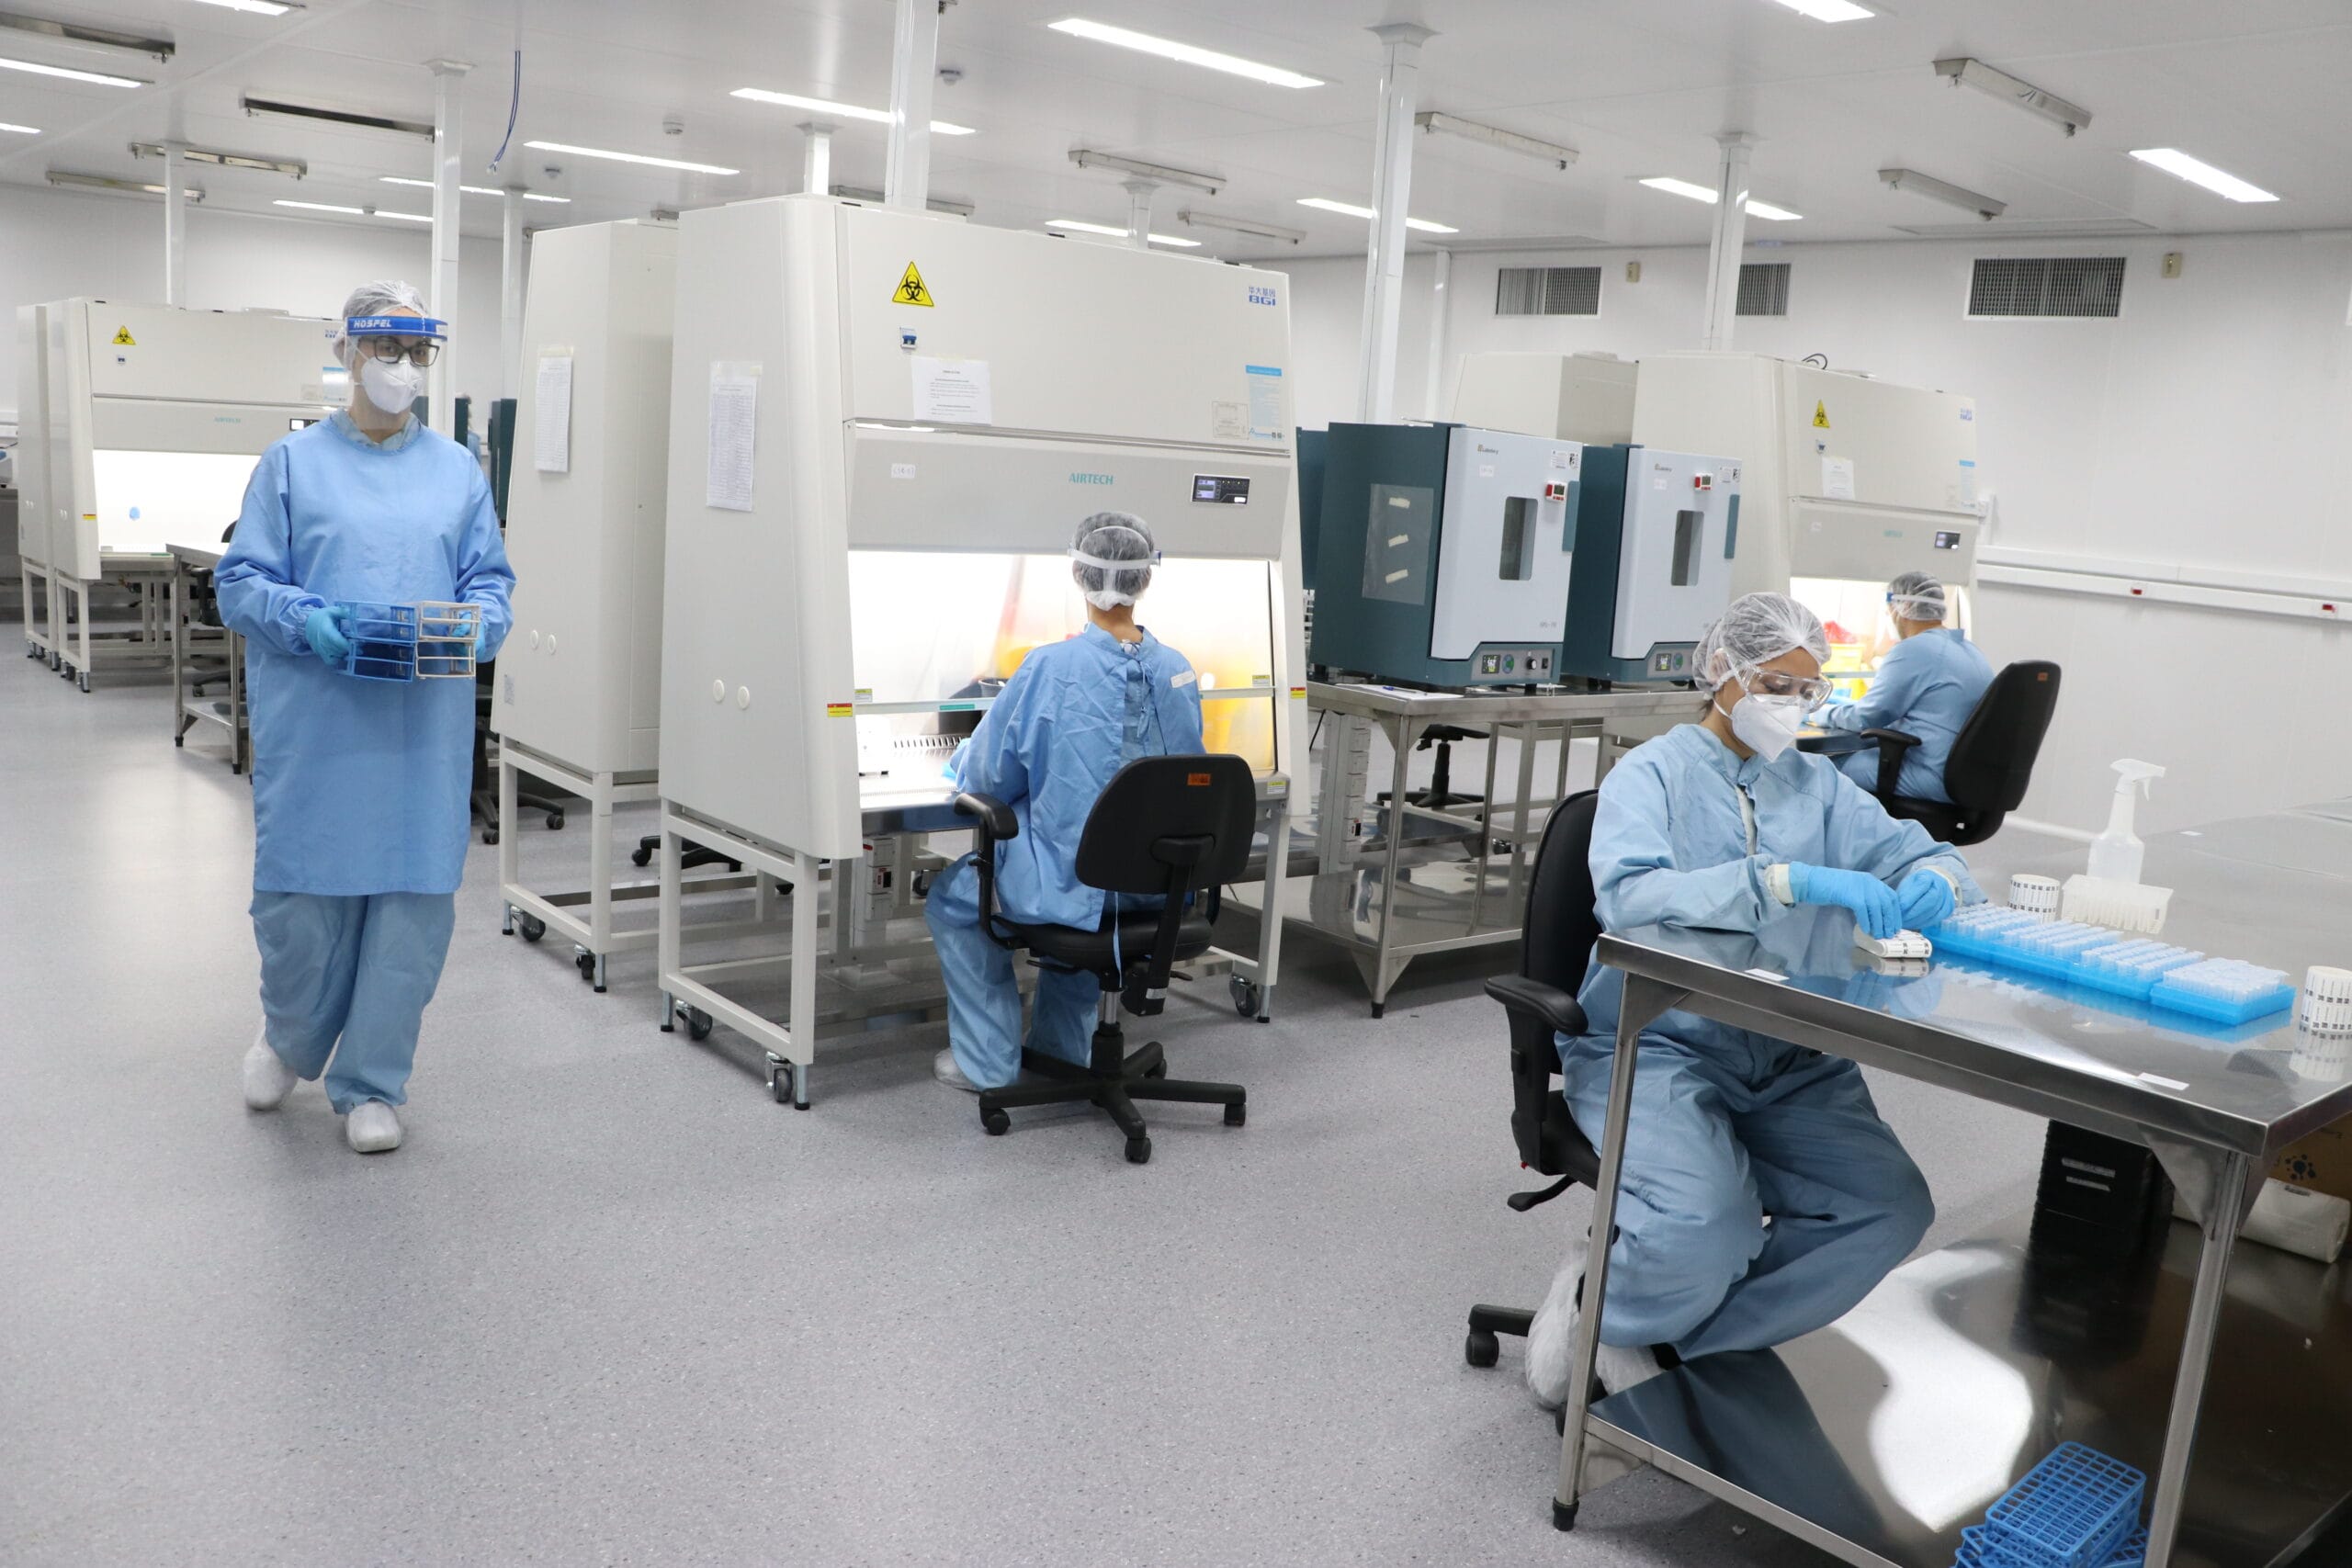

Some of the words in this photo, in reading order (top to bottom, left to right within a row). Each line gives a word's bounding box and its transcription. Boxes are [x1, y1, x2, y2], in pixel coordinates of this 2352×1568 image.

[1249, 294, 1276, 306] BGI
[353, 319, 392, 329] HOSPEL
[1069, 472, 1114, 485] AIRTECH
